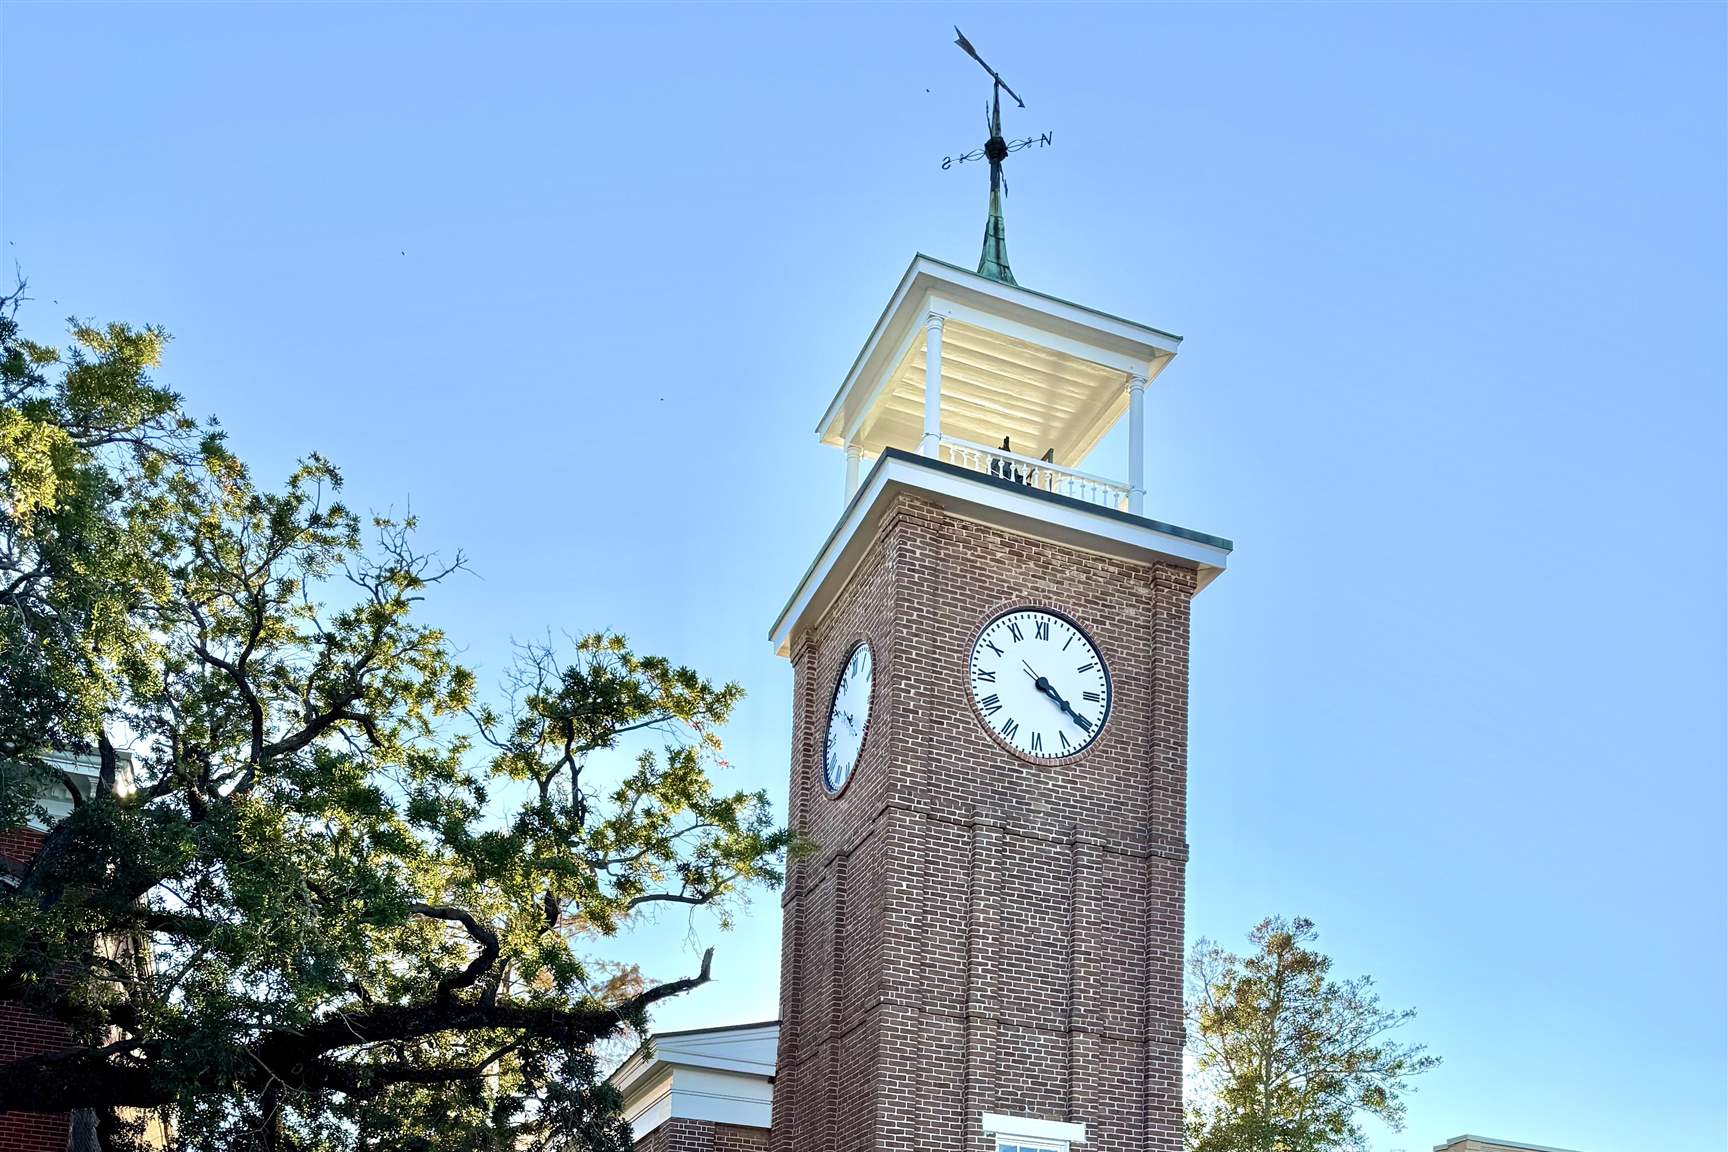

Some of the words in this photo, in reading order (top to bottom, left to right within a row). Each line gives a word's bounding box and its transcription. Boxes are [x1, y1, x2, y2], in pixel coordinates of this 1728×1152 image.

[1007, 622, 1024, 643] XI
[1035, 620, 1049, 641] XII
[986, 640, 1004, 658] X
[977, 668, 996, 683] IX
[1077, 663, 1094, 674] II
[981, 694, 1003, 716] VIII
[1083, 691, 1100, 702] III
[1001, 717, 1019, 740] VII
[1031, 731, 1043, 752] VI
[1059, 730, 1071, 749] V
